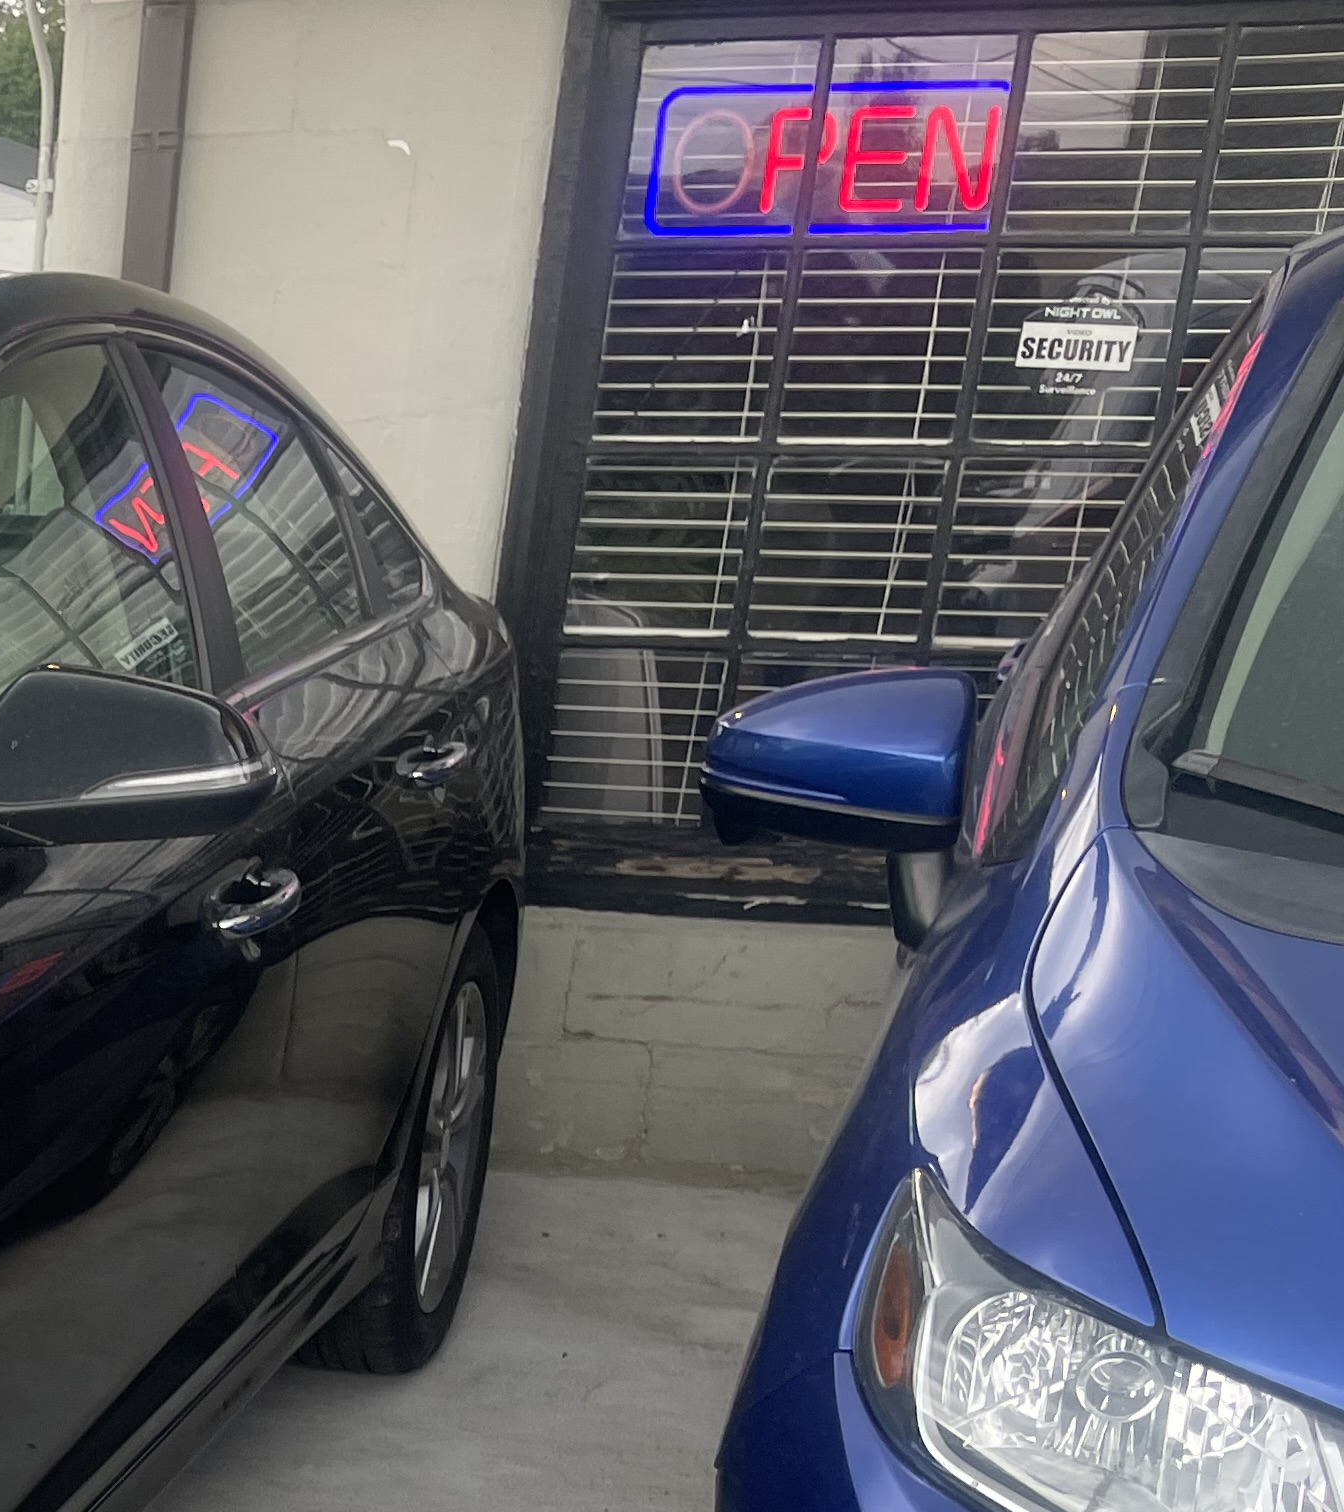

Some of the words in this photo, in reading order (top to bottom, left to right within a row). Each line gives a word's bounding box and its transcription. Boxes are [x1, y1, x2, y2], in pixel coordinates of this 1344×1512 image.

[672, 104, 1003, 215] OPEN
[1044, 306, 1091, 318] NIGHT
[1091, 308, 1121, 320] OWL
[1020, 337, 1132, 363] SECURITY
[1055, 371, 1084, 383] 24/7
